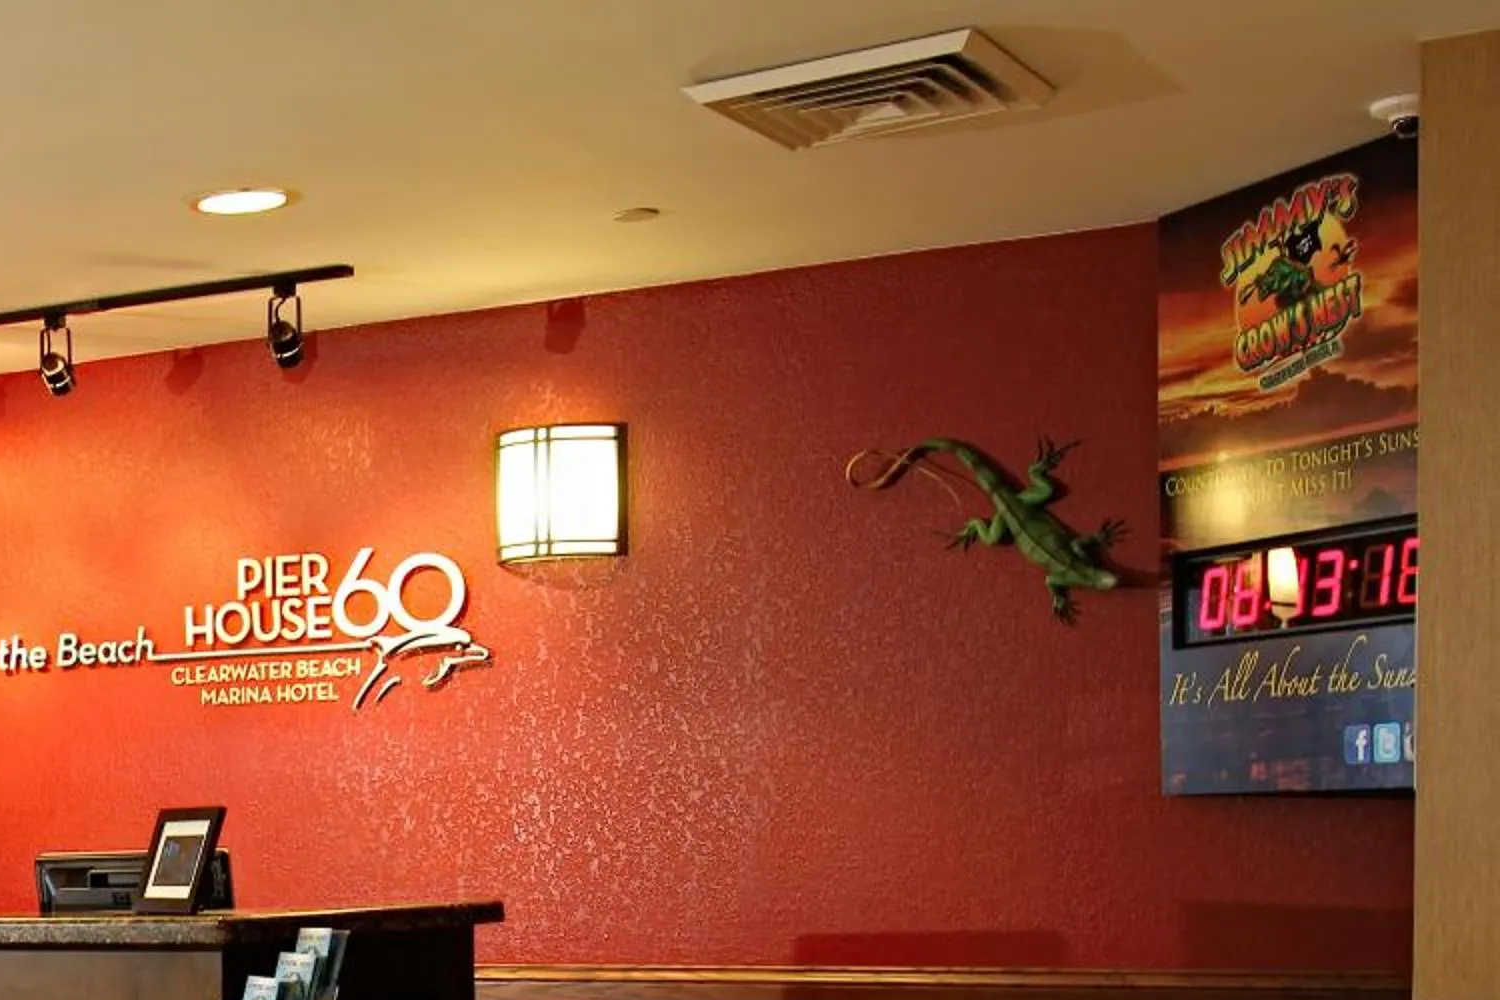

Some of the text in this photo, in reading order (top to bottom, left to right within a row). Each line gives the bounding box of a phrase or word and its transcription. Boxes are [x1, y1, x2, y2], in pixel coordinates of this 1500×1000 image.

[1311, 273, 1362, 333] NEST
[1267, 456, 1284, 477] TO
[1290, 437, 1373, 472] TONIGHT'S
[1290, 475, 1326, 499] MISS
[237, 552, 329, 600] PIER
[332, 547, 466, 638] 60
[184, 596, 333, 646] HOUSE
[56, 625, 153, 667] Beach
[171, 657, 361, 685] CLEARWATER BEACH
[200, 681, 339, 706] MARINA HOTEL
[1169, 671, 1203, 705] It's
[1207, 650, 1259, 708] All
[1253, 646, 1322, 702] About
[1328, 634, 1367, 695] the
